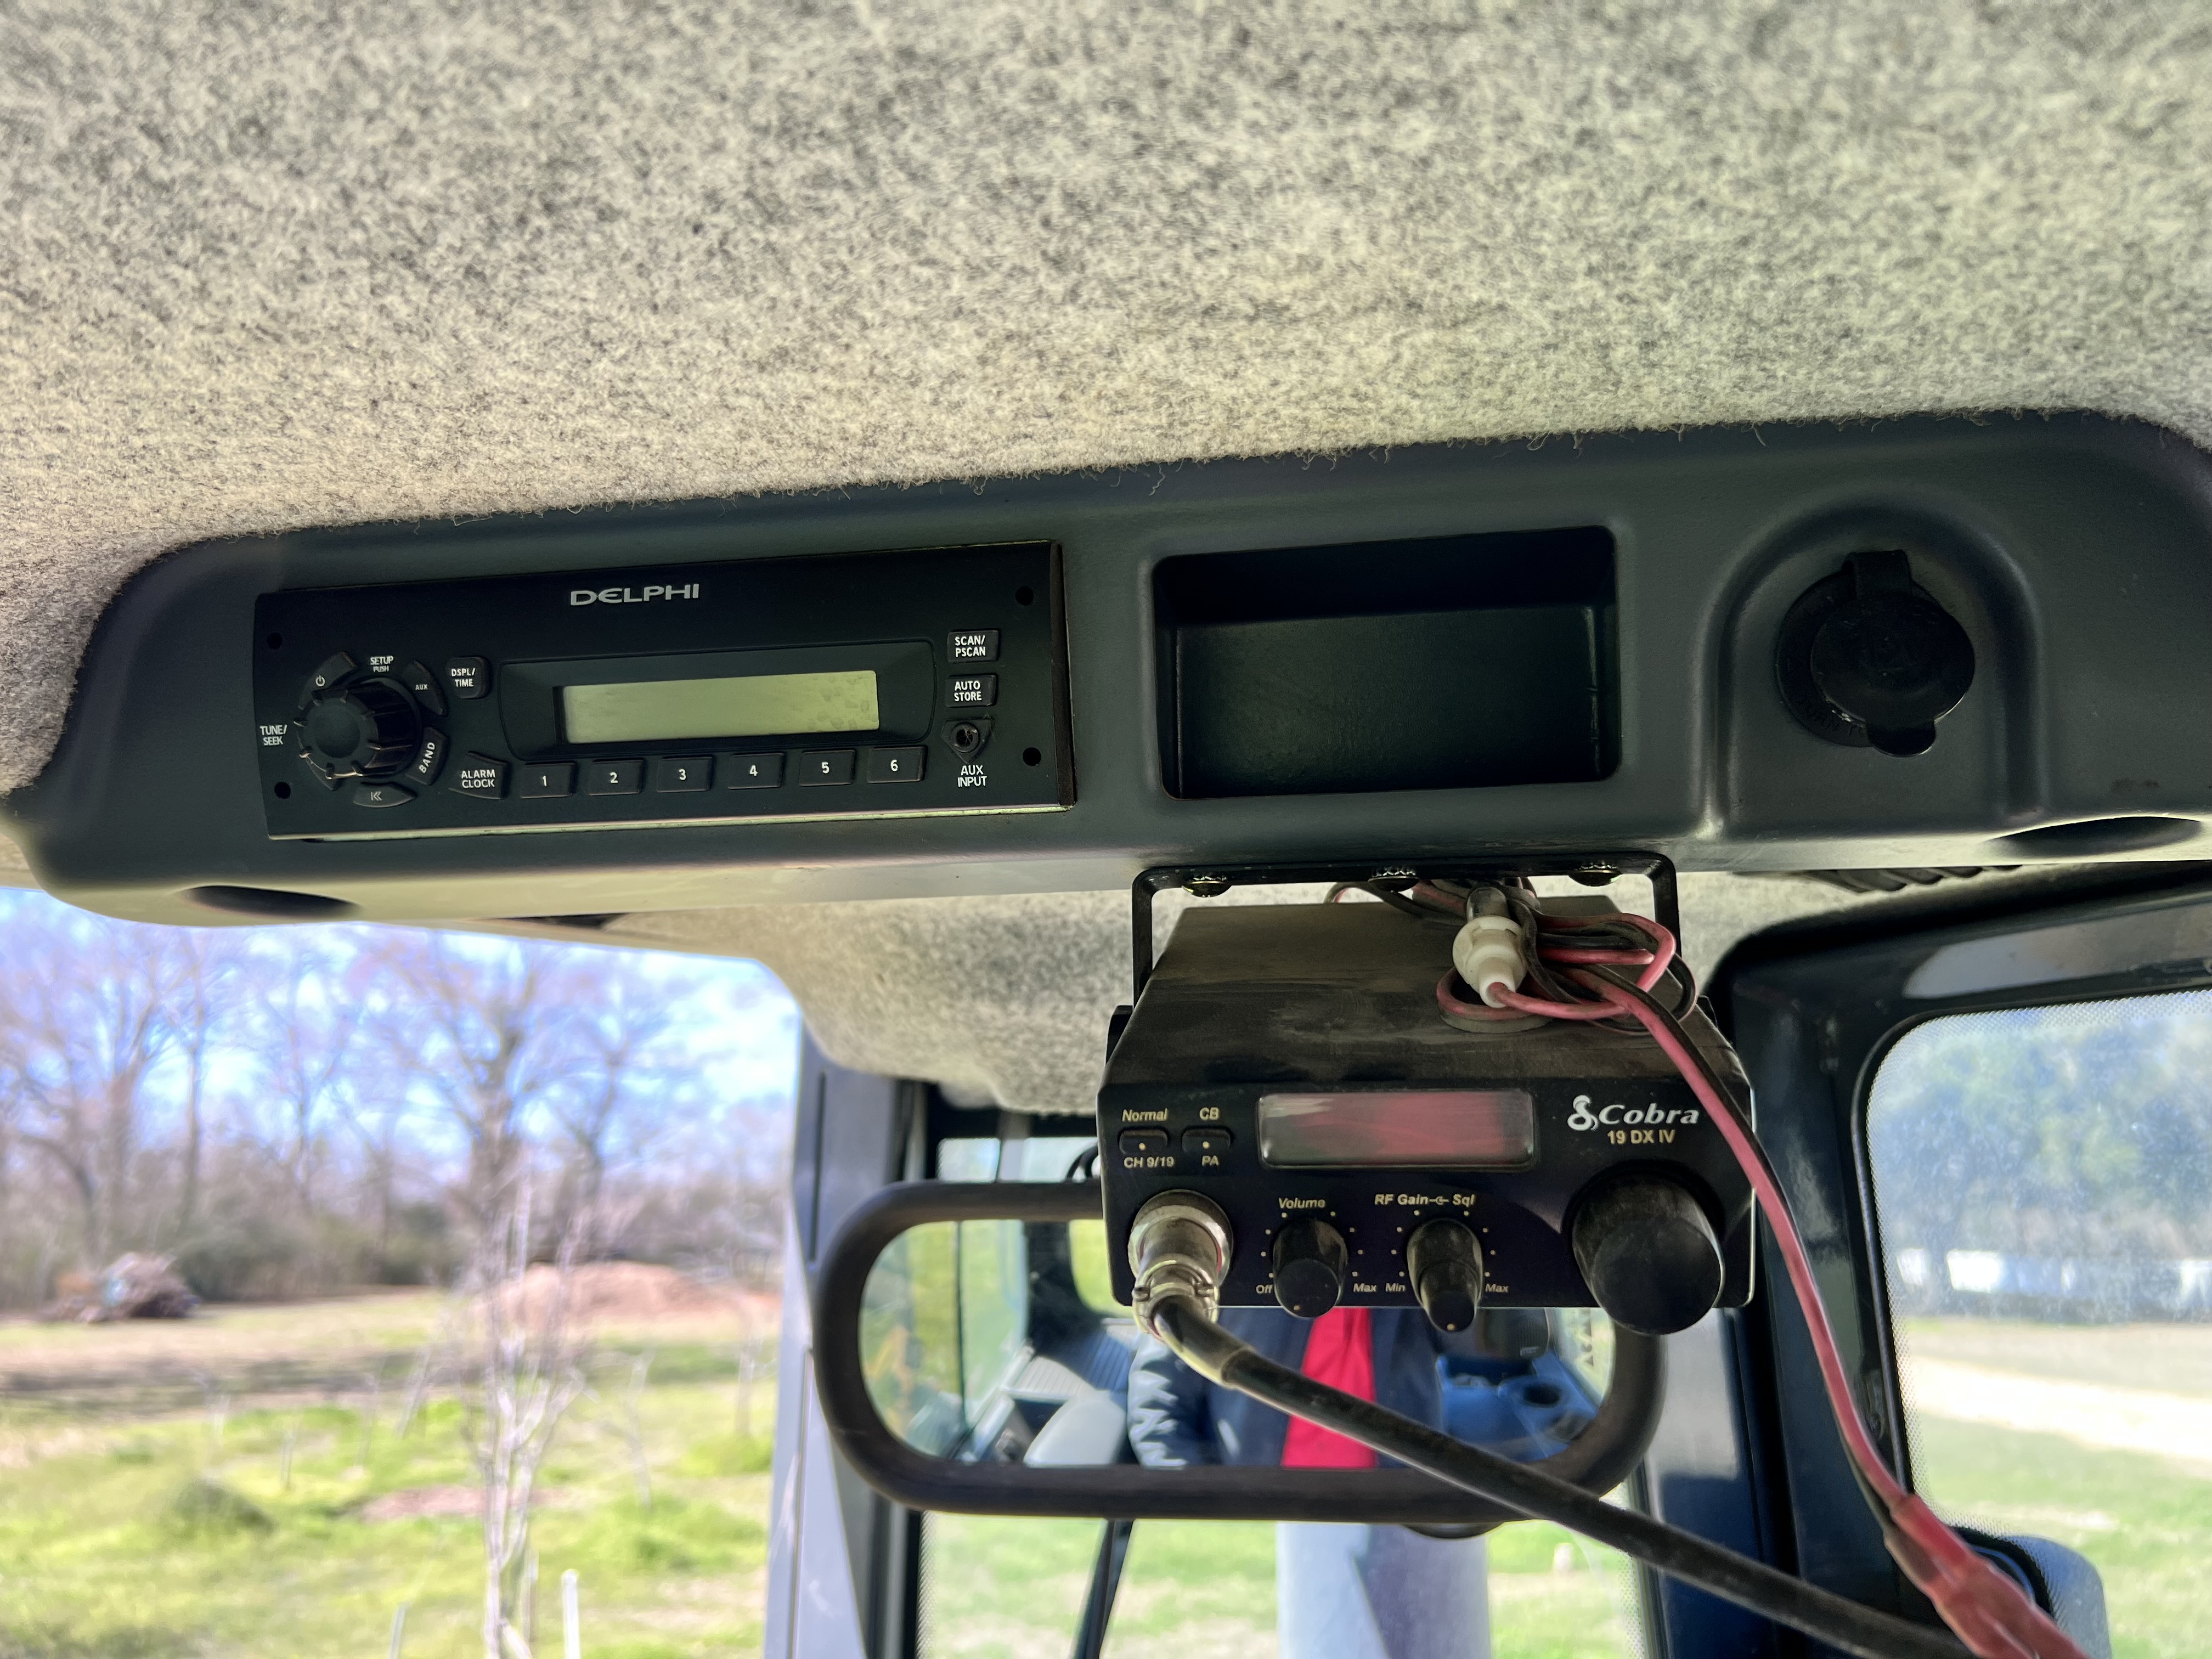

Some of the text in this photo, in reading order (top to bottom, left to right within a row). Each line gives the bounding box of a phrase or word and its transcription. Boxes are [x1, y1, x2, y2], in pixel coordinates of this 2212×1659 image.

[570, 583, 699, 606] DELPHI
[955, 635, 985, 646] SCAN/
[955, 646, 986, 657] PSCAN
[370, 655, 394, 665] SETUP
[451, 668, 476, 676] DSPL/
[454, 678, 473, 687] TIME
[954, 680, 981, 691] AUTO
[953, 691, 982, 702] STORE
[259, 724, 287, 736] TUNE/
[263, 736, 284, 746] SEEK
[419, 742, 435, 774] BAND
[749, 765, 758, 776] 4
[821, 761, 830, 774] 5
[890, 759, 899, 772] 6
[961, 764, 984, 776] AUX
[461, 769, 495, 781] ALARM
[610, 771, 618, 783] 2
[679, 769, 686, 780] 3
[461, 778, 495, 788] CLOCK
[542, 775, 547, 787] 1
[957, 775, 988, 787] INPUT
[1122, 1108, 1168, 1122] Normal
[1199, 1107, 1220, 1121] CB
[1597, 1103, 1699, 1127] Cobra
[1607, 1129, 1675, 1144] 19 DX IV
[1124, 1156, 1175, 1169] CH 9/19
[1201, 1155, 1219, 1166] PA
[1278, 1197, 1325, 1209] Volume
[1374, 1193, 1475, 1207] RF Gain Sql
[1256, 1284, 1273, 1294] Off
[1353, 1283, 1377, 1293] Max
[1385, 1283, 1406, 1292] Min
[1485, 1283, 1509, 1293] Max
